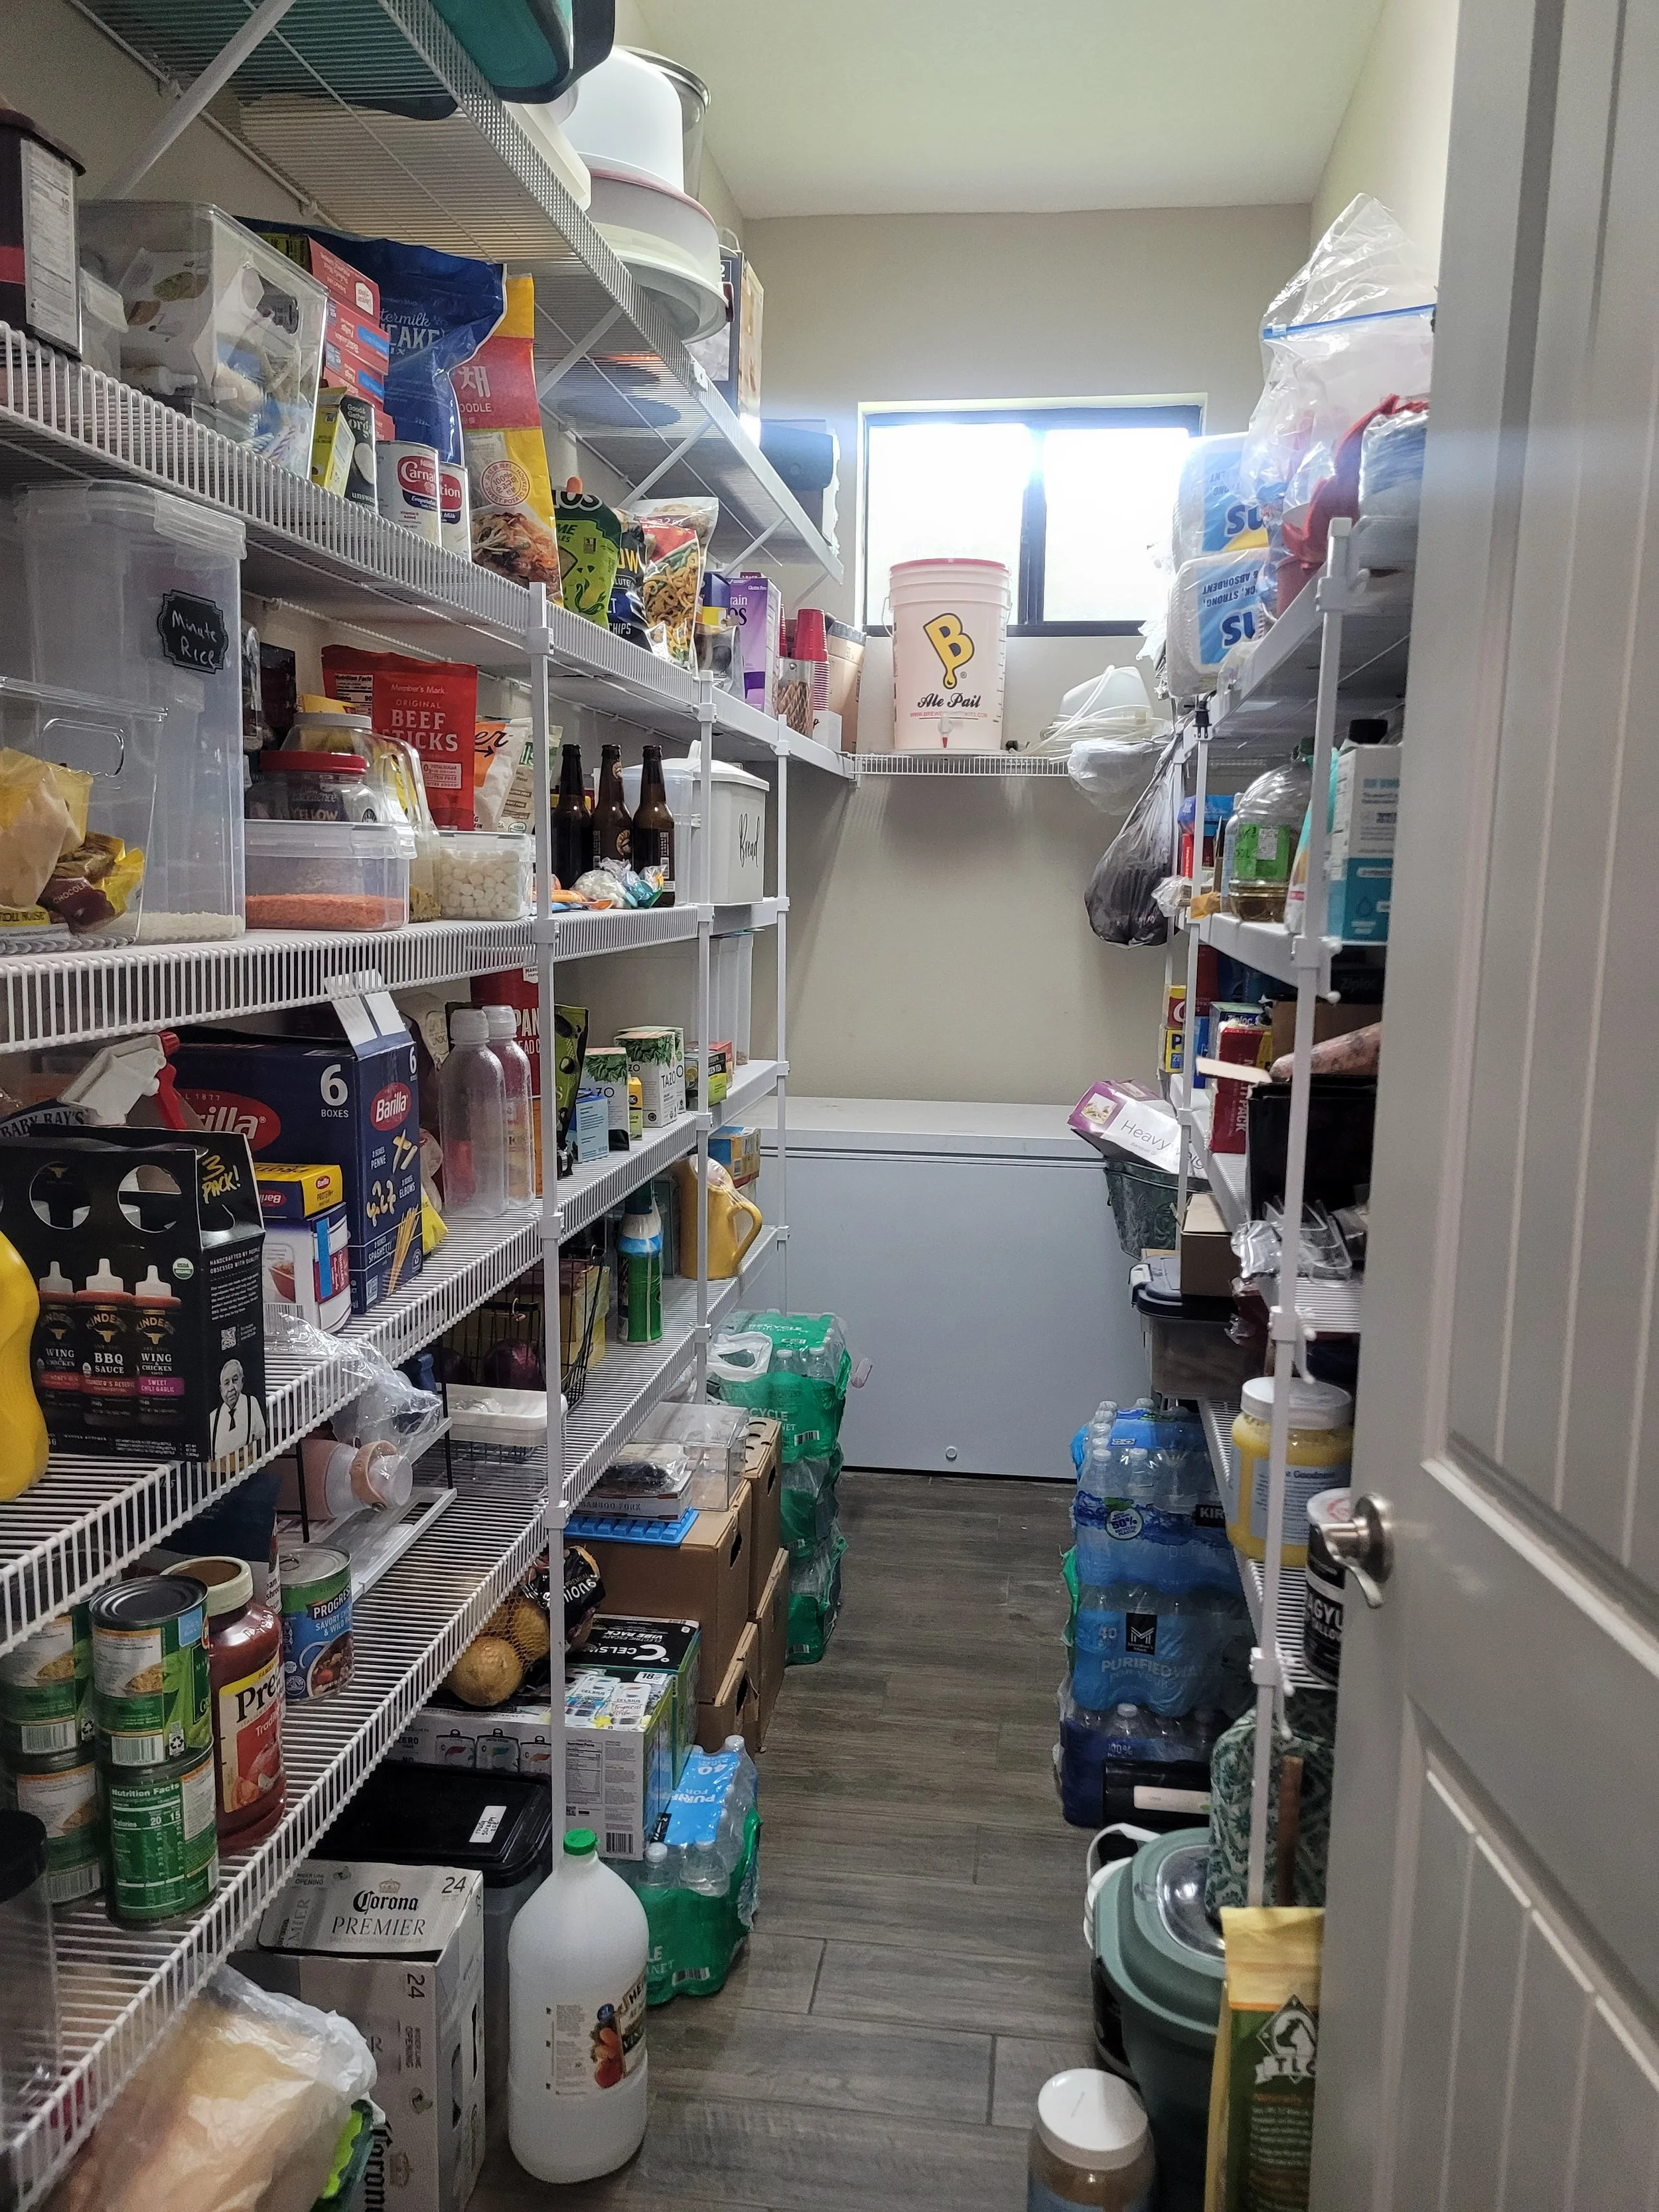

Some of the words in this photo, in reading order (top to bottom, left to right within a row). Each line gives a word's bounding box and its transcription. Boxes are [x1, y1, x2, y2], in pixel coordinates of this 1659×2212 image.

[493, 471, 513, 485] 100%
[484, 486, 503, 503] SWEET
[503, 491, 526, 505] POTATO
[1202, 570, 1250, 595] ABSORBENT
[1202, 590, 1239, 607] STRONG,
[172, 609, 218, 643] Minute
[390, 684, 425, 694] Member's
[426, 685, 446, 695] Mark
[395, 700, 442, 709] ORIGINAL
[917, 693, 945, 708] Ale
[947, 692, 981, 708] Pail
[390, 709, 447, 731] BEEF
[738, 812, 760, 869] Bread
[409, 1046, 417, 1074] 6
[321, 1064, 348, 1106] 6
[661, 1072, 676, 1089] TAZO
[321, 1109, 349, 1118] BOXES
[376, 1090, 407, 1123] Barilla
[44, 1110, 84, 1125] RAY'S
[202, 1155, 225, 1182] 3
[371, 1154, 386, 1170] PENNE
[202, 1165, 242, 1205] PACK!
[399, 1182, 416, 1199] ELBOWS
[209, 1252, 242, 1266] HANDCRAFTED
[368, 1241, 394, 1264] SPAGHETTI
[210, 1262, 234, 1274] OBSESSED
[234, 1259, 245, 1268] WITH
[46, 1348, 75, 1358] WING
[94, 1352, 124, 1366] BBQ
[141, 1353, 173, 1363] WING
[94, 1365, 125, 1374] SAUCE
[1111, 1515, 1138, 1529] 50%
[315, 1613, 340, 1631] SAVORY
[697, 1763, 729, 1776] 40
[111, 1788, 151, 1798] Nutrition
[153, 1783, 180, 1795] Facts
[113, 1818, 137, 1828] Calories
[150, 1816, 163, 1826] 20
[170, 1810, 181, 1822] 15
[441, 1876, 467, 1895] 24
[352, 1889, 419, 1915] Corona
[331, 1915, 427, 1937] PREMIER
[407, 1972, 425, 1999] 24
